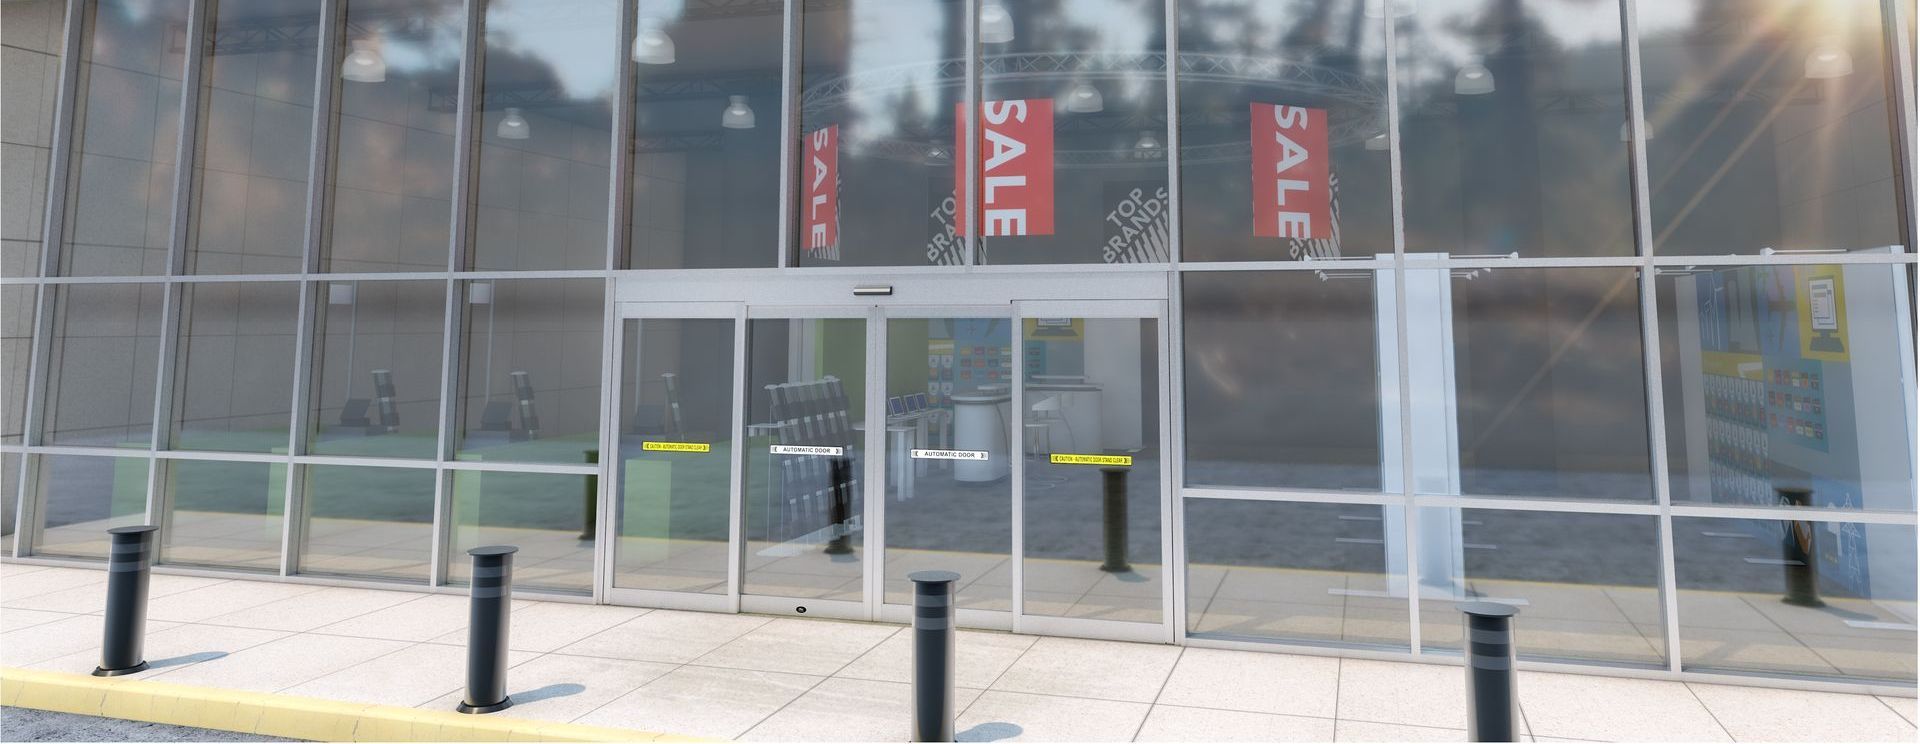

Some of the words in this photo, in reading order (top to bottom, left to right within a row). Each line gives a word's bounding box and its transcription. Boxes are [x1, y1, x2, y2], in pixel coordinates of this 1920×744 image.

[812, 127, 828, 249] SALE
[930, 190, 956, 224] TO
[984, 100, 1026, 236] SALE
[1106, 188, 1143, 227] TOP
[1275, 104, 1311, 238] SALE
